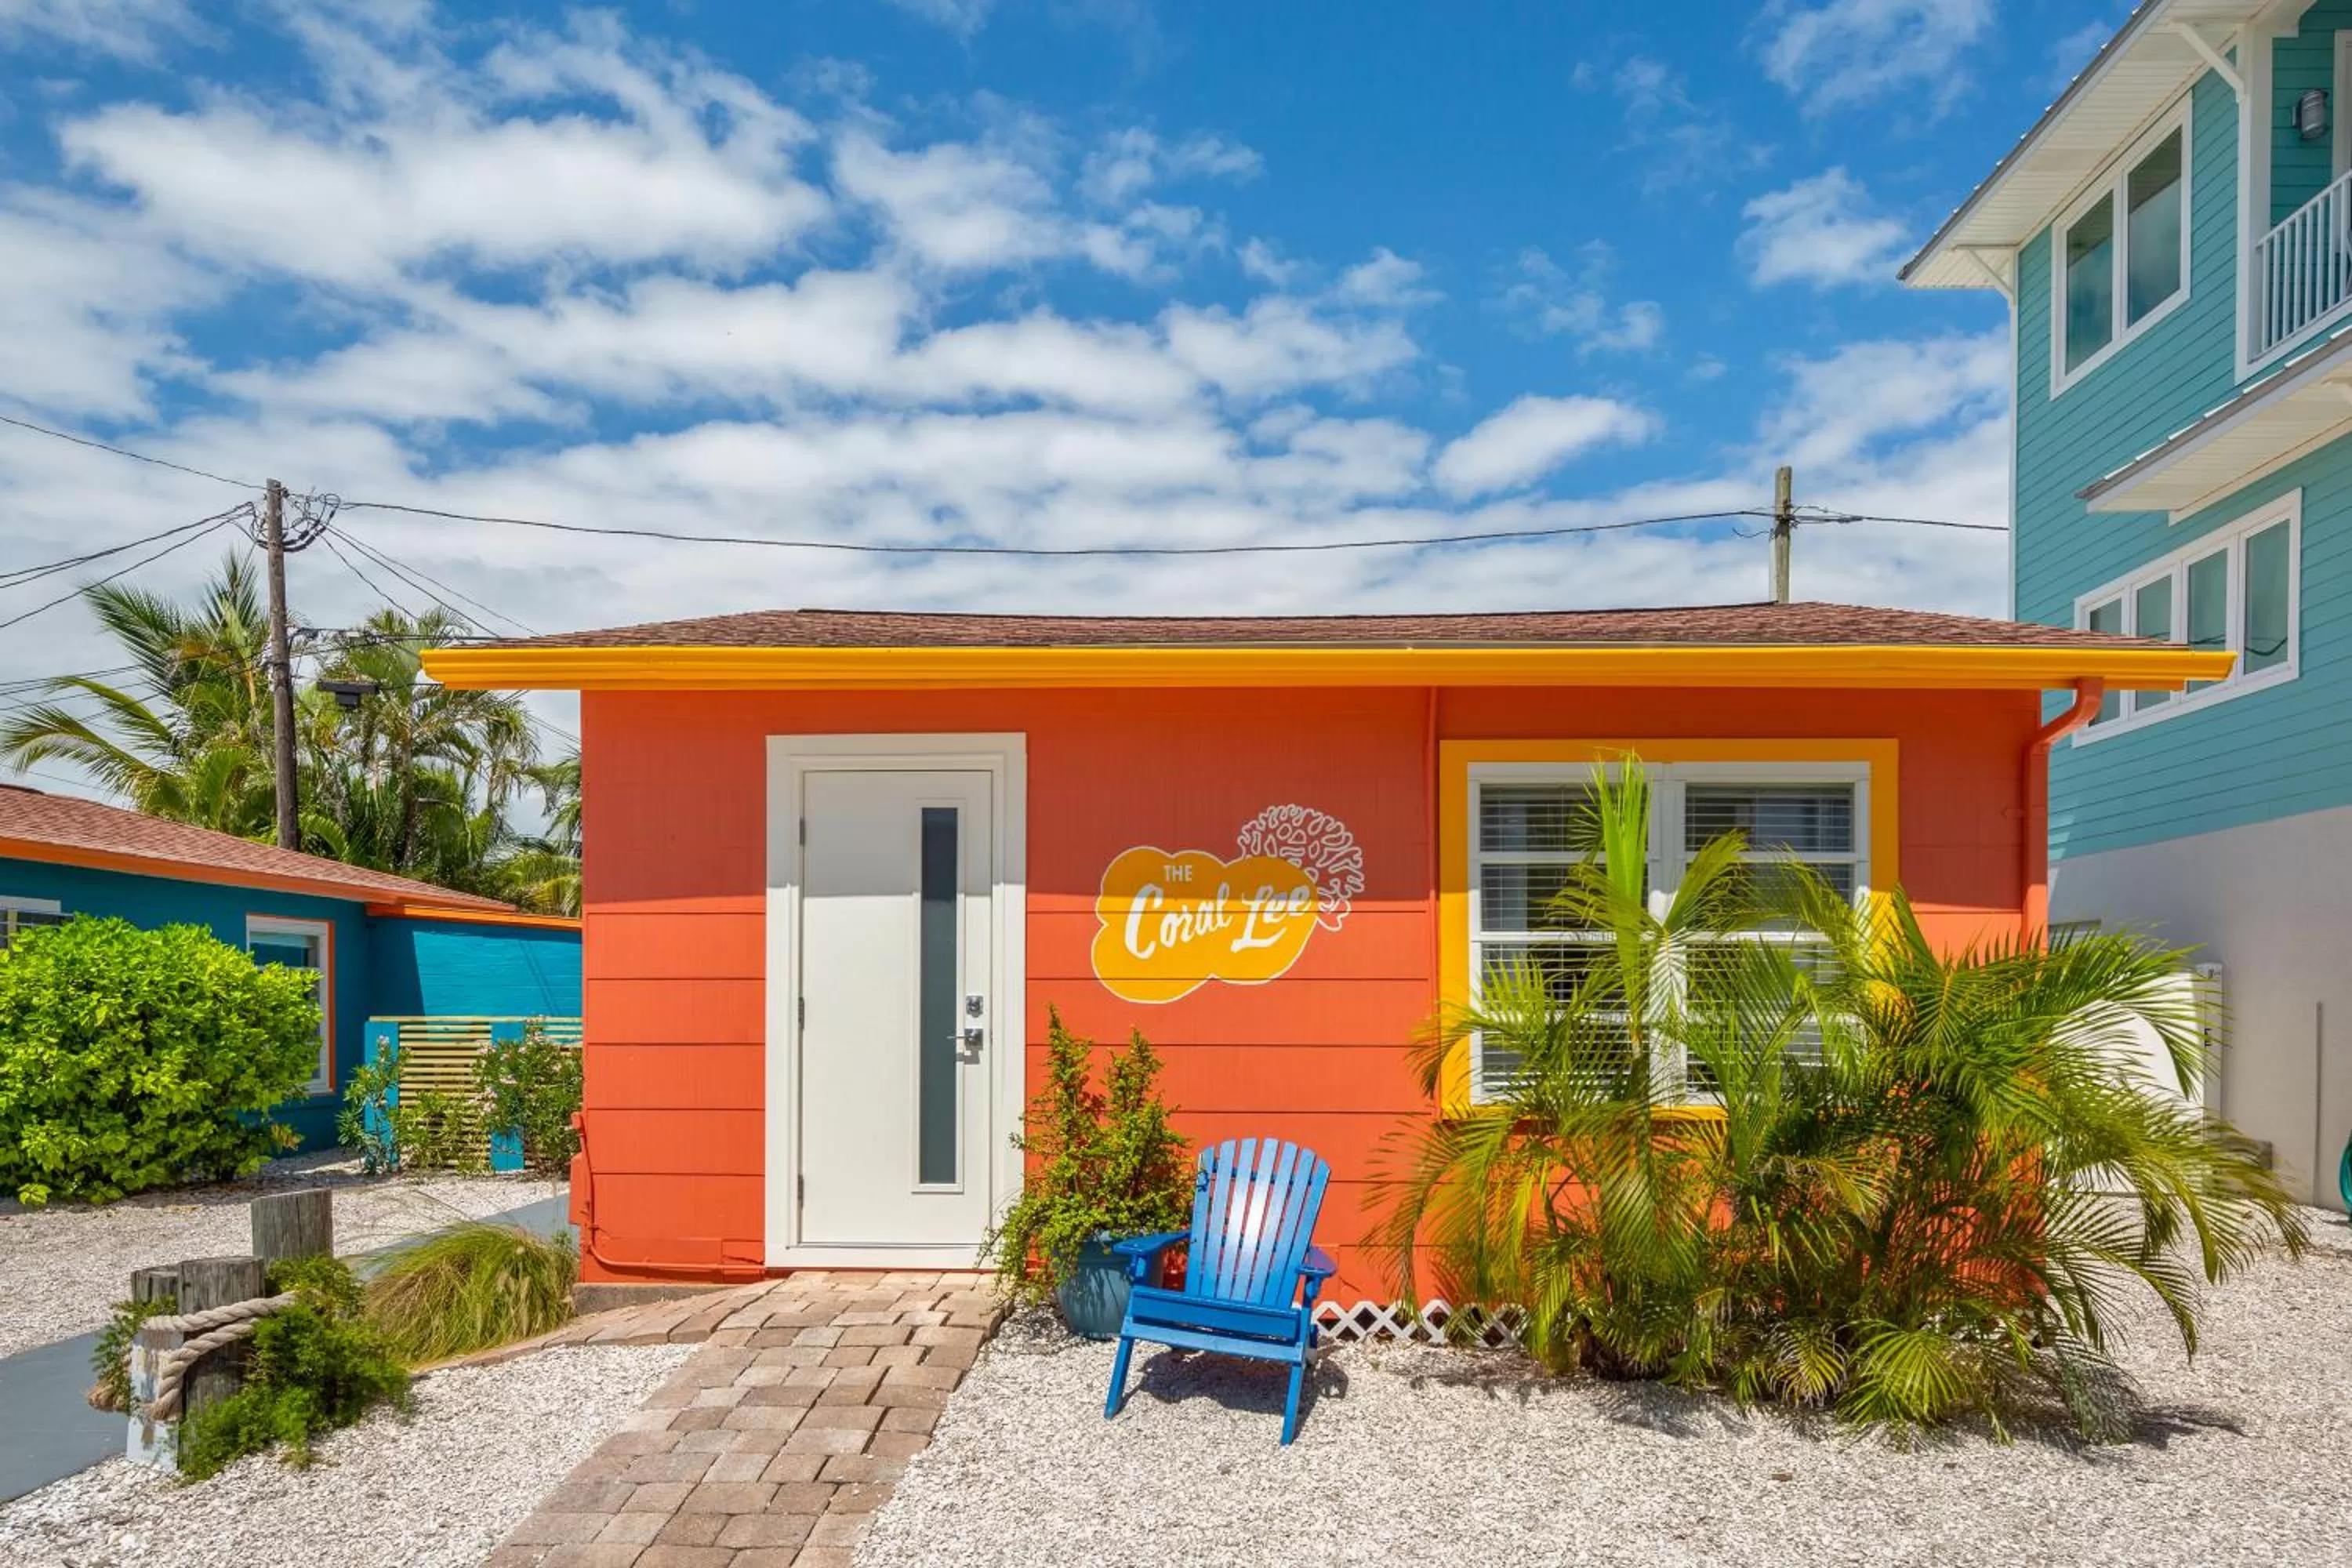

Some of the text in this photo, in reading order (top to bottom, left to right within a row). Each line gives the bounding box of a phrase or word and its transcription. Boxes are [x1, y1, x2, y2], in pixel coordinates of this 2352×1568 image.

[1163, 865, 1192, 883] THE
[1124, 883, 1312, 960] Coral Lee
